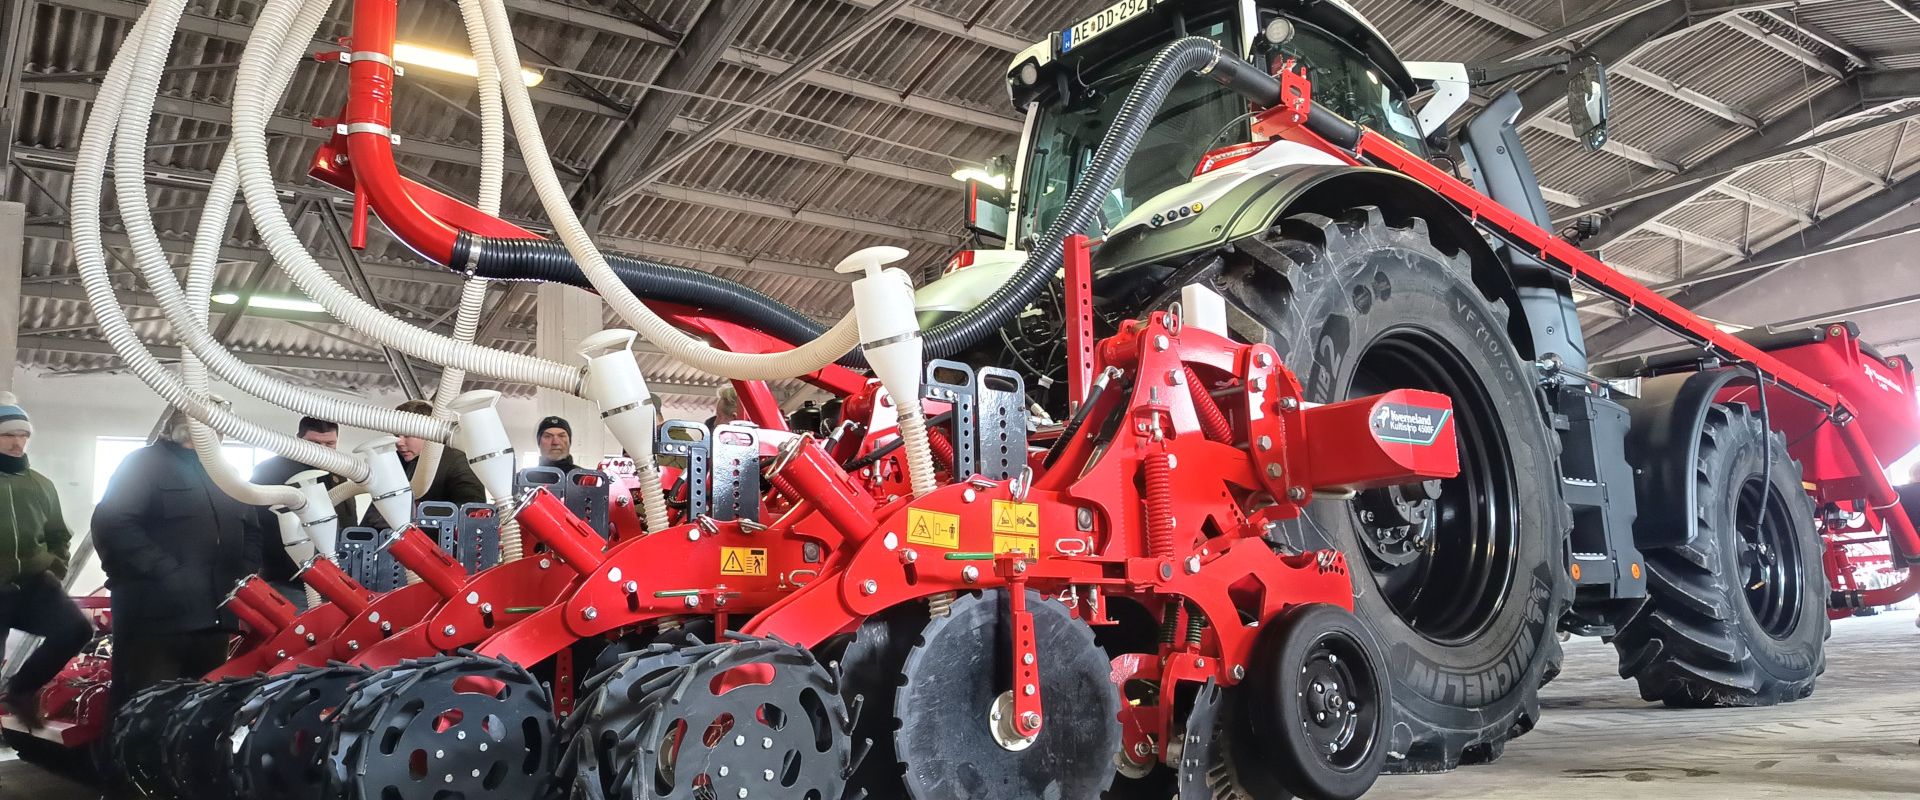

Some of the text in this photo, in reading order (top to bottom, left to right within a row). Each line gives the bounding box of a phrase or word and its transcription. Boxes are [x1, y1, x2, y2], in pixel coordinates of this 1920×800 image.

[1073, 0, 1145, 44] AE DD-292
[1320, 334, 1341, 380] 2
[1390, 410, 1432, 425] Kverneland
[1390, 421, 1418, 434] Kultistrip
[1406, 625, 1536, 706] MICHELIN
